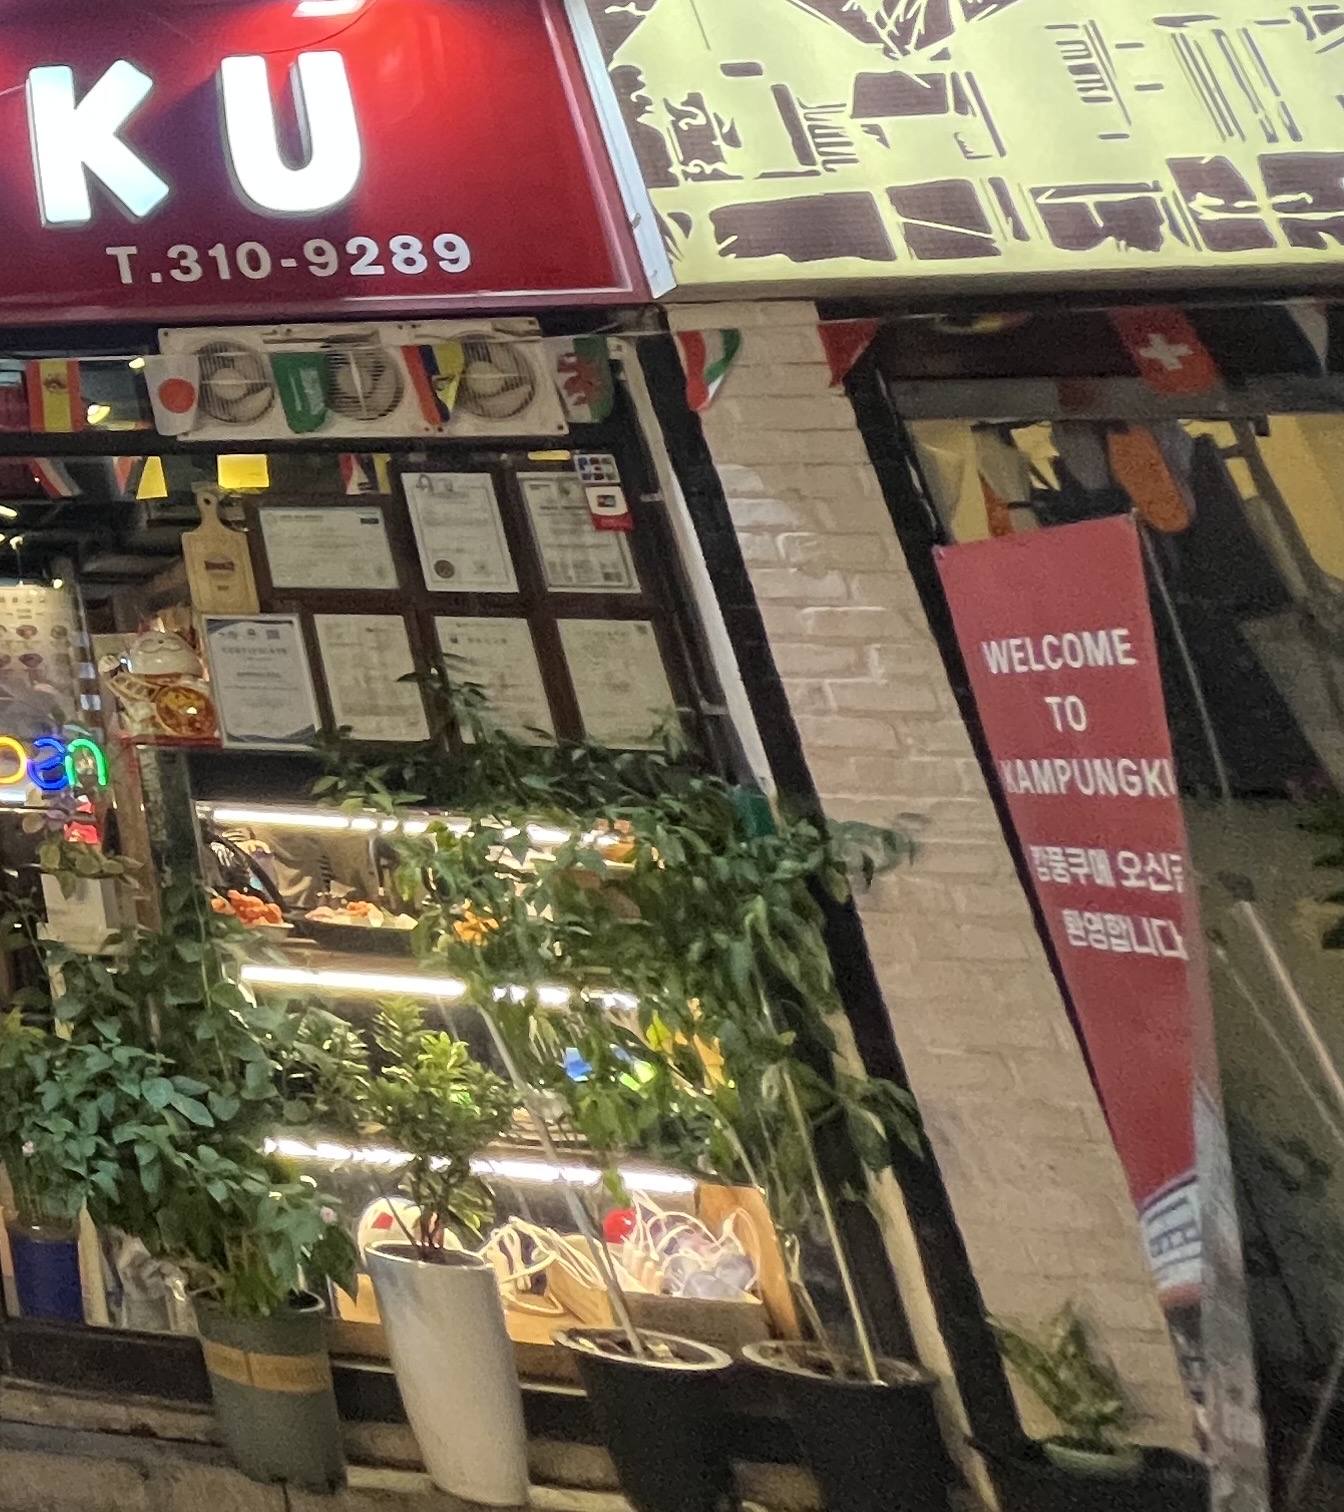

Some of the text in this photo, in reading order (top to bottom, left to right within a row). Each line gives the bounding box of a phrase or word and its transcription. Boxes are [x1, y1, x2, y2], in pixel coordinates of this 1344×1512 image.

[106, 233, 471, 286] T.310-9289
[982, 629, 1138, 675] WELCOME
[1044, 695, 1087, 733] TO
